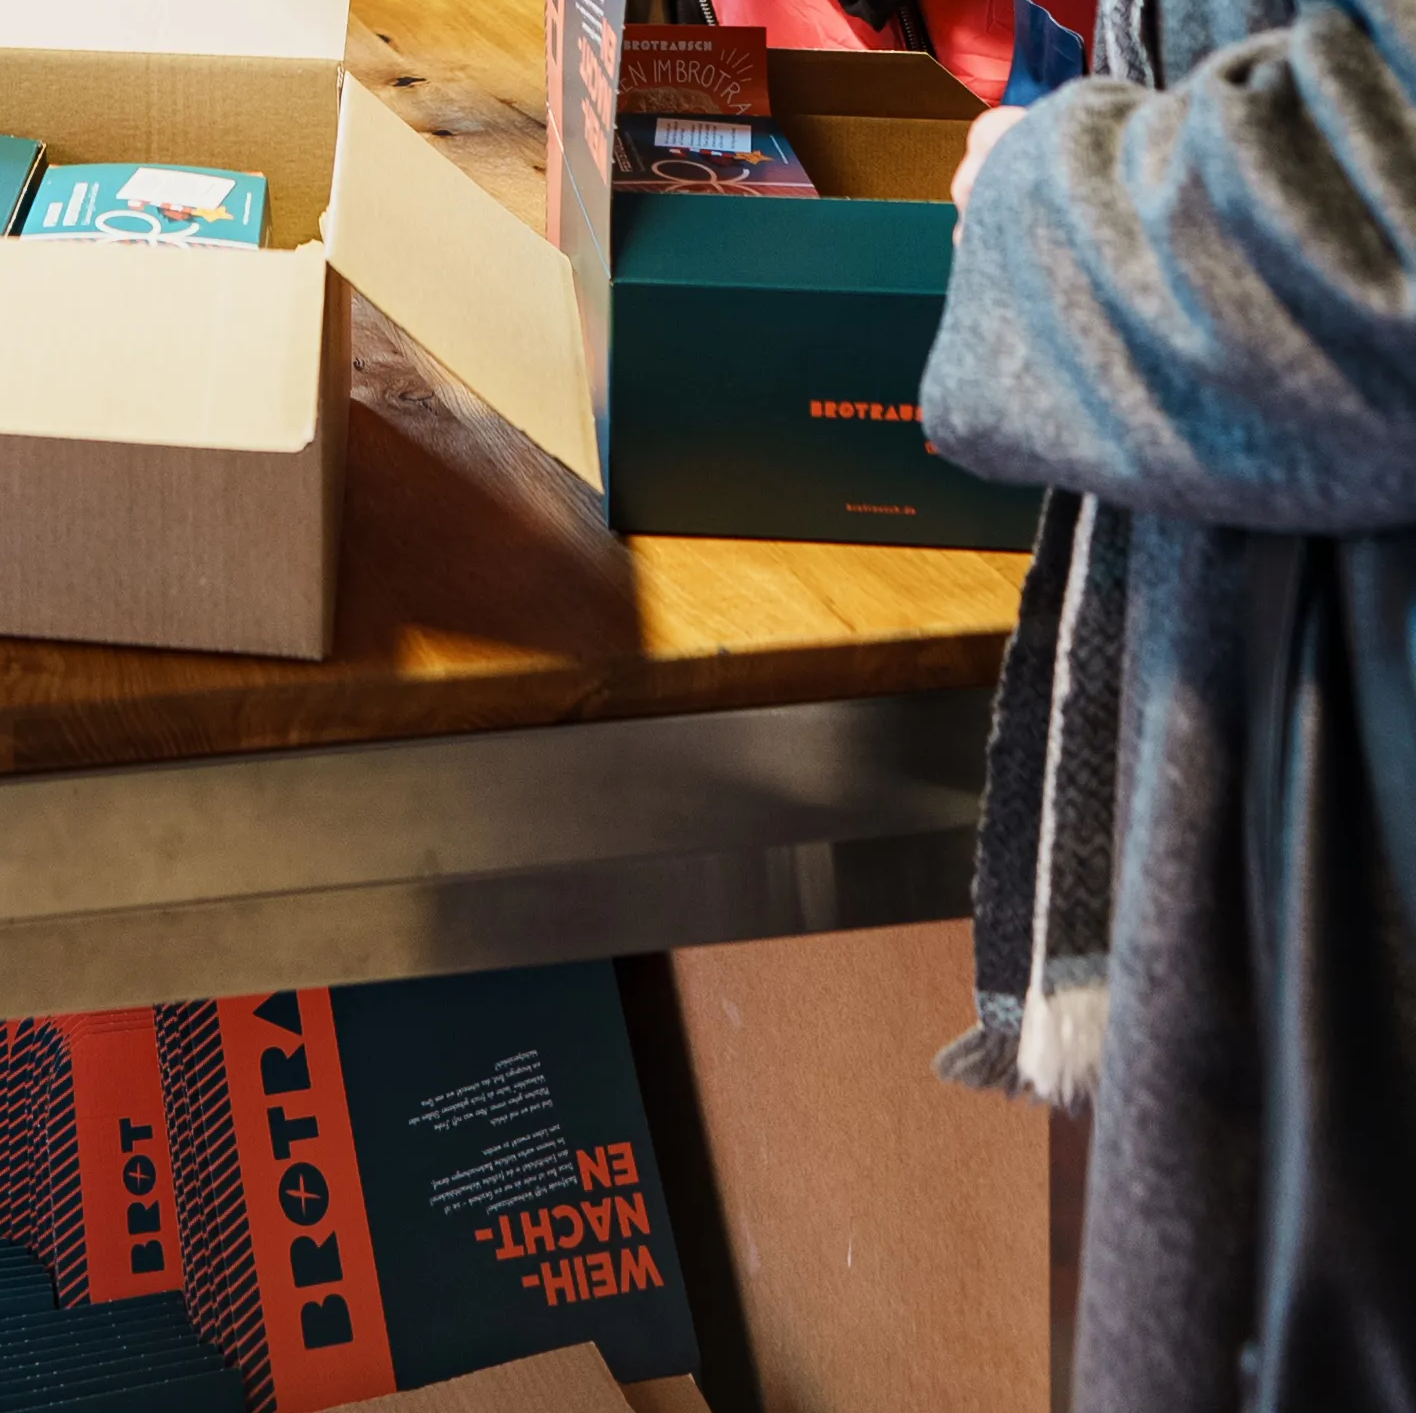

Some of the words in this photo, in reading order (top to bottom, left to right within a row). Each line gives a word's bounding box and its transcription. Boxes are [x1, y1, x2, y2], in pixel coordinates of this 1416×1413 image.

[120, 1116, 166, 1274] BROT
[576, 1141, 639, 1191] EN
[474, 1192, 650, 1260] NACHT-
[521, 1245, 664, 1307] WEIH-
